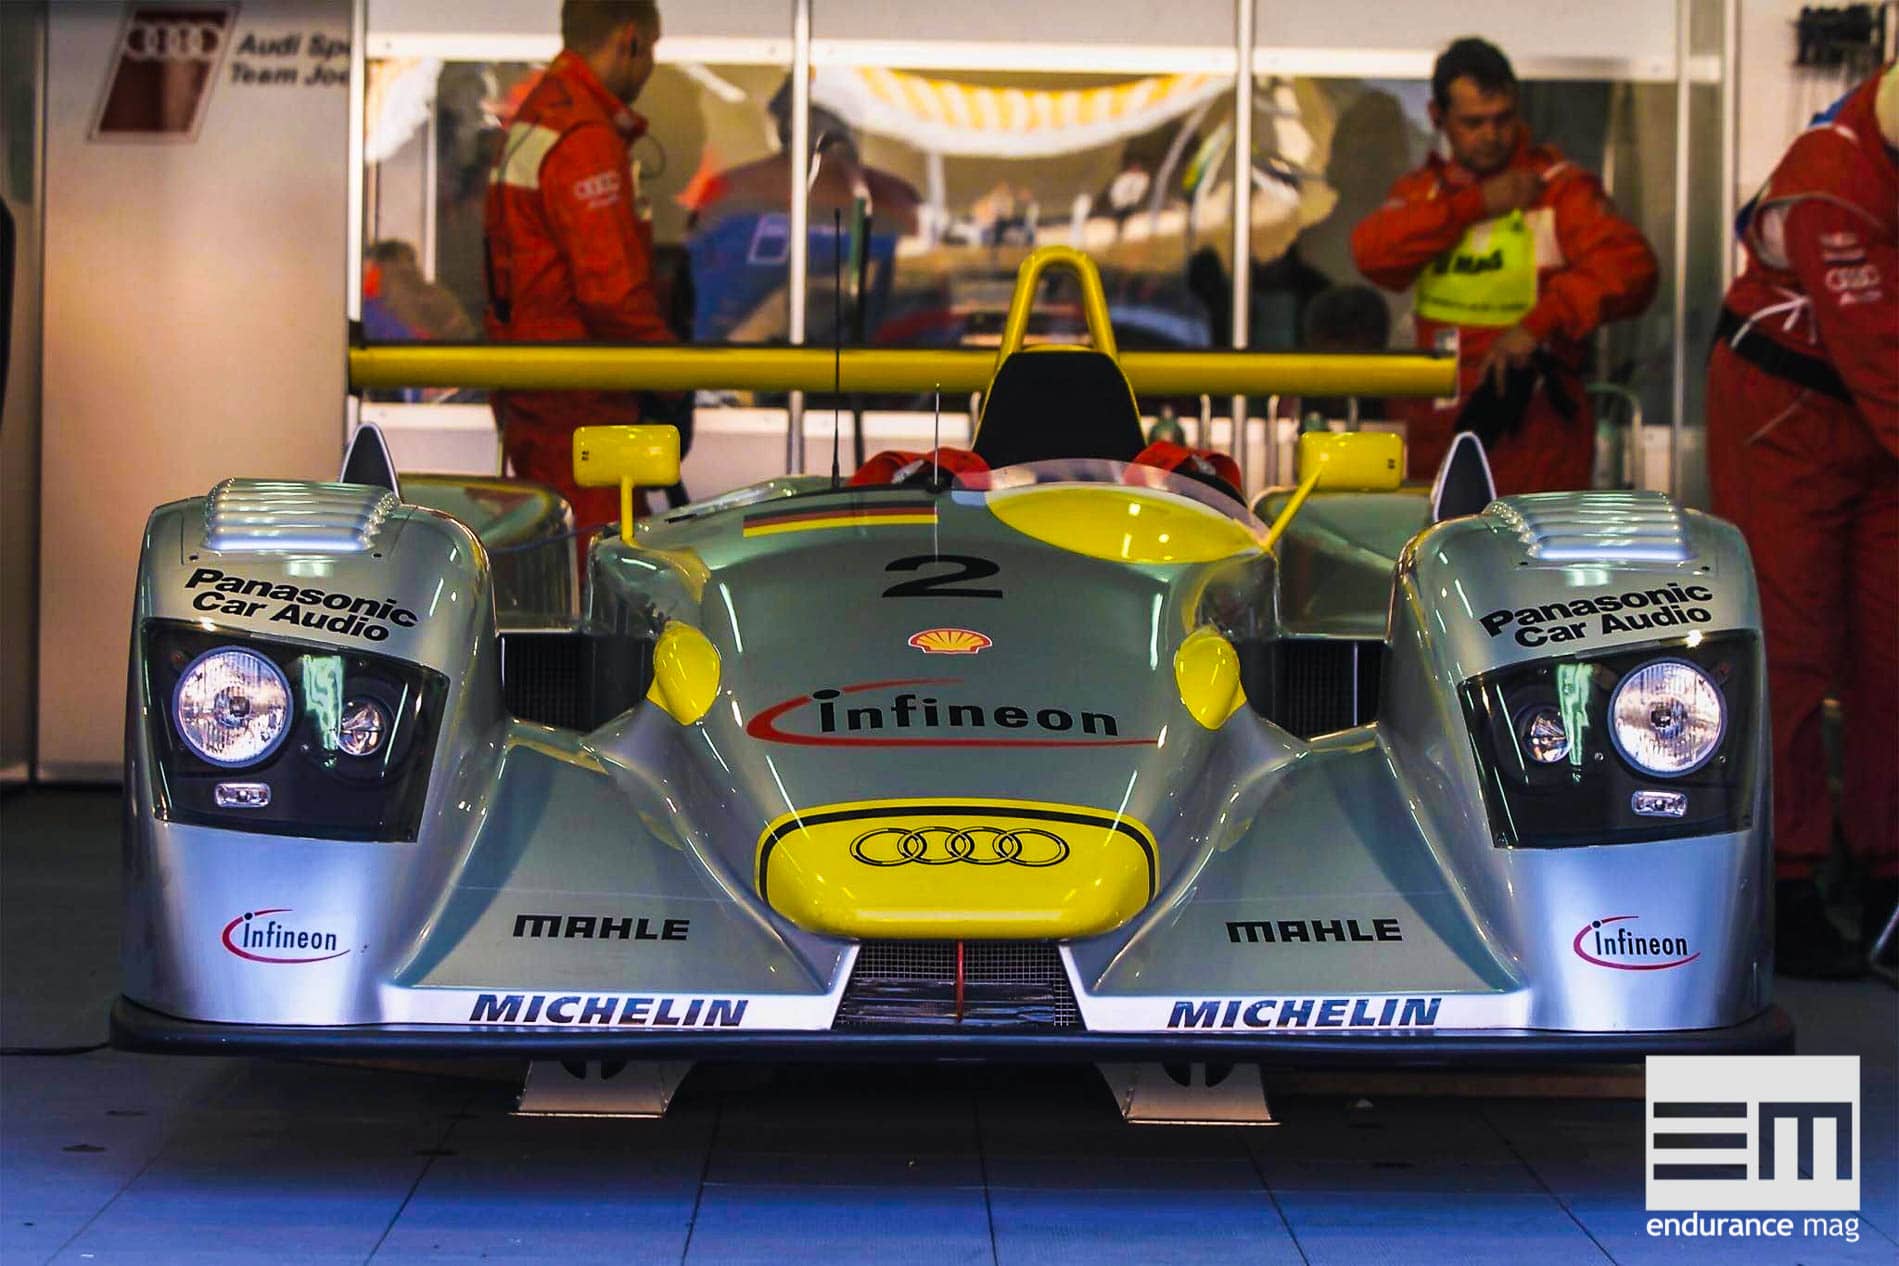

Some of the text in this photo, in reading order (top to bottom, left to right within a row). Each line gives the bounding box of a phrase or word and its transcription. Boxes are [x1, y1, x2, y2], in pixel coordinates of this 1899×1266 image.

[237, 33, 302, 56] Audi
[231, 63, 297, 84] Team
[882, 554, 1003, 598] 2
[184, 567, 419, 628] Panasonic
[1479, 582, 1713, 638] Panasonic
[192, 591, 390, 642] Car Audio
[1514, 604, 1713, 648] Car Audio
[512, 914, 690, 941] MAHLE
[1225, 918, 1403, 943] MAHLE
[469, 993, 748, 1027] MICHELIN
[1167, 997, 1442, 1028] MICHELIN
